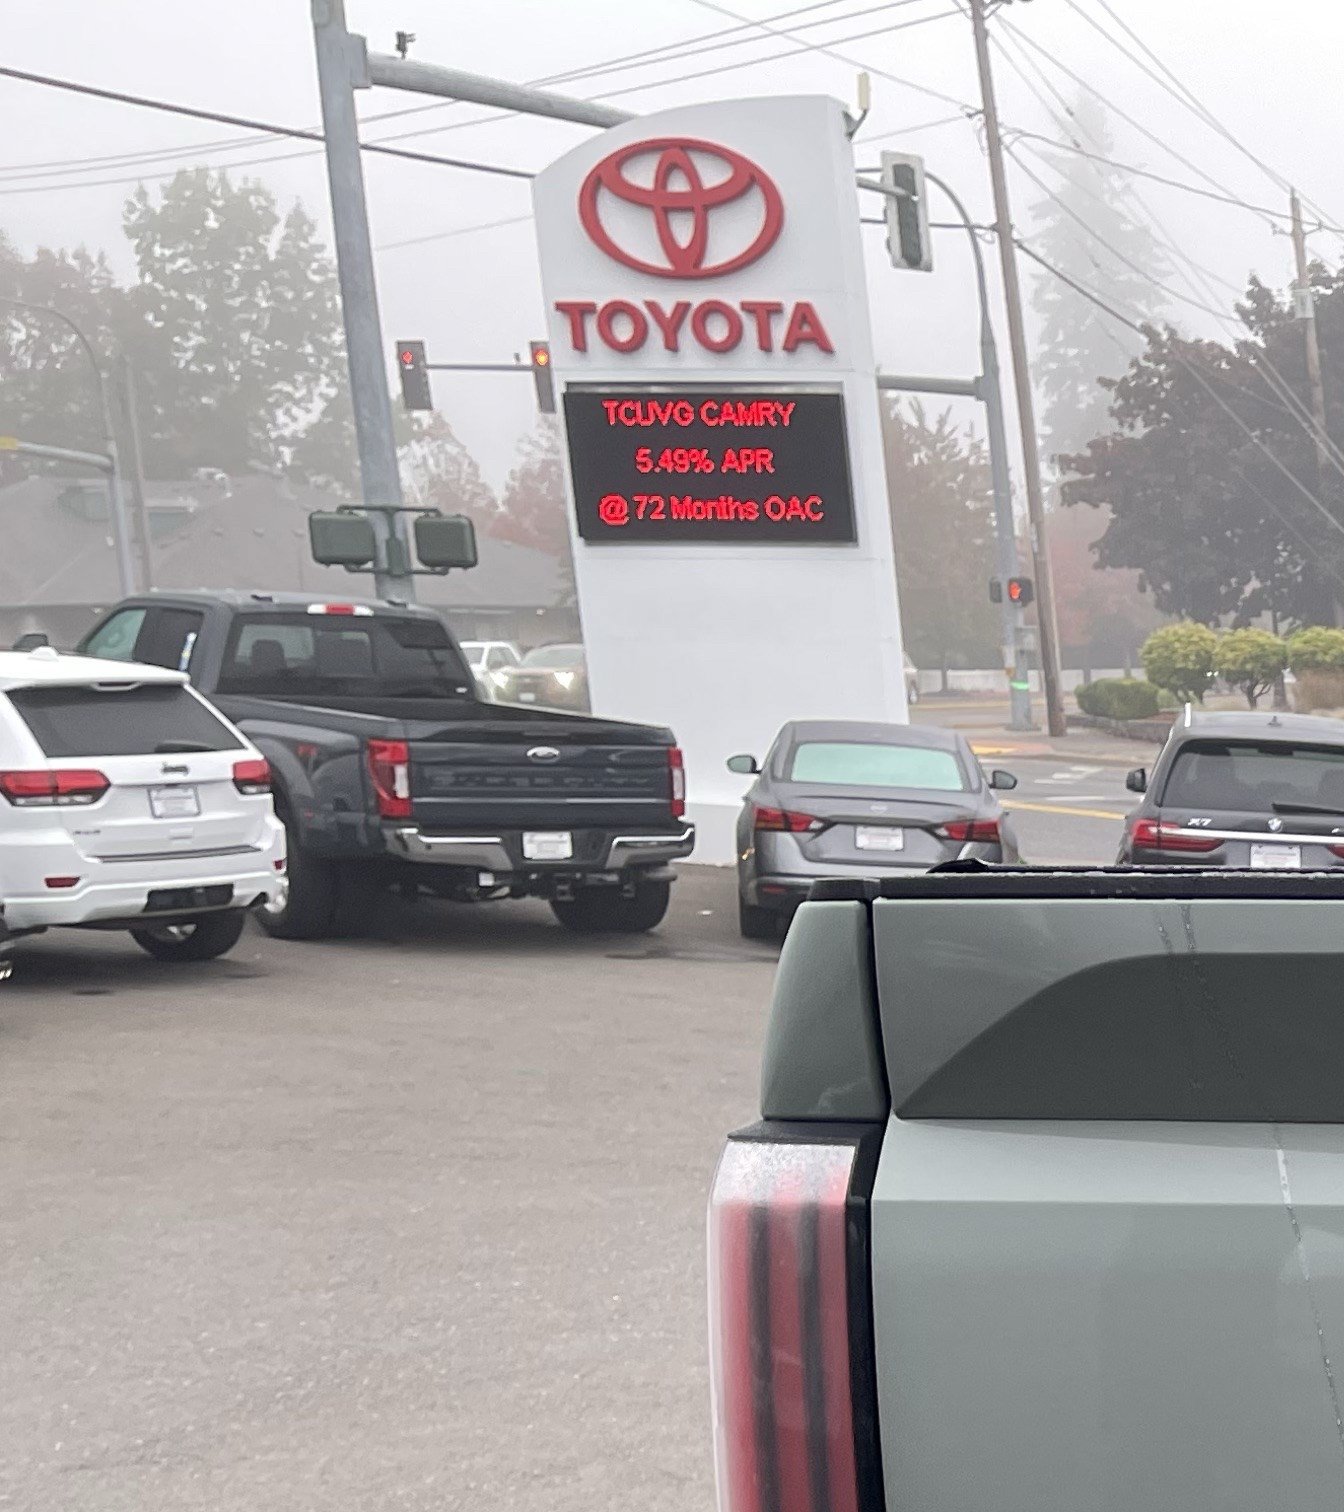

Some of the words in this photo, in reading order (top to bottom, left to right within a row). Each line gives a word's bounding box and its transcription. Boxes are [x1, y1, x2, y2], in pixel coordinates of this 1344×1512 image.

[555, 299, 835, 355] TOYOTA
[699, 399, 797, 427] CAMRY
[635, 446, 715, 474] 5.49%
[720, 447, 775, 474] APR
[598, 493, 630, 526] @
[632, 494, 666, 520] 72
[670, 494, 760, 521] Months
[764, 494, 824, 521] OAC
